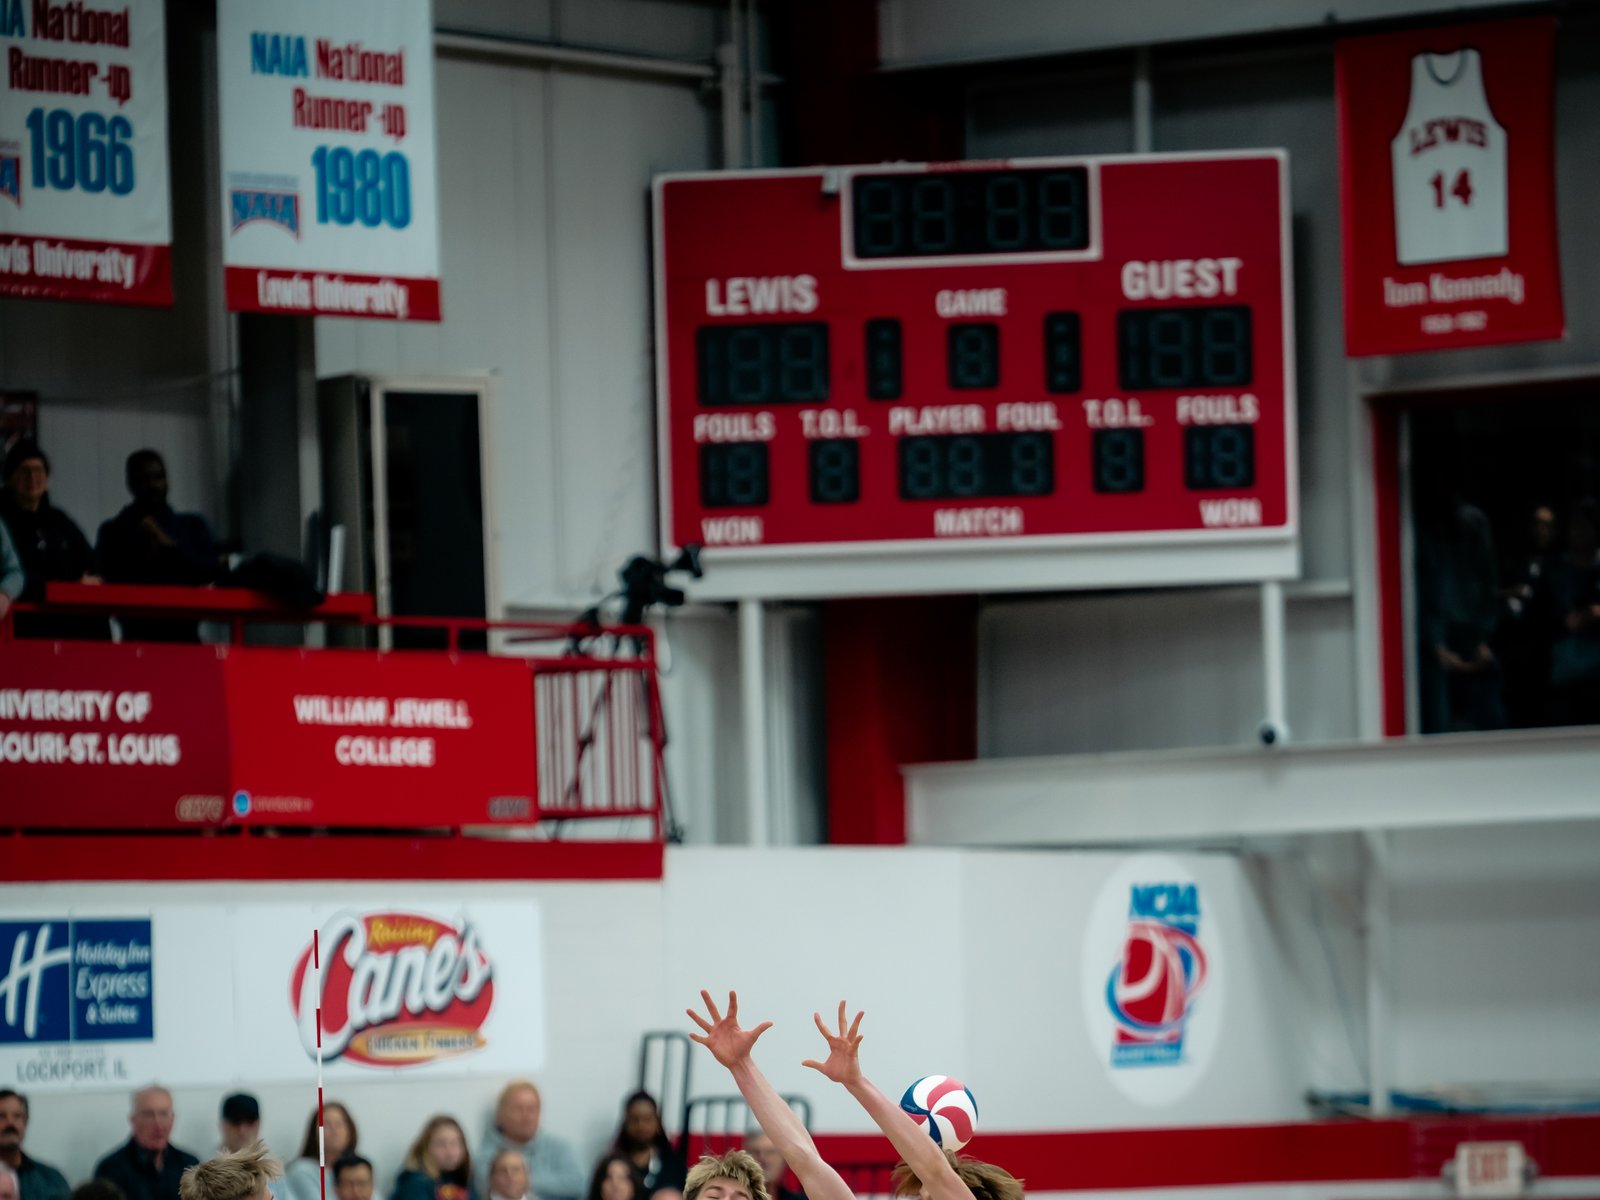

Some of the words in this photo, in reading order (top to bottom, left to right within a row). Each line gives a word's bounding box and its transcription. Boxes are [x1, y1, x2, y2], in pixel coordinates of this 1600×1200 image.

[31, 0, 130, 48] National
[8, 46, 131, 106] Runner-up
[250, 32, 309, 78] NAIA
[315, 39, 404, 87] National
[293, 87, 405, 139] Runner-up
[26, 107, 136, 196] 1966
[1410, 117, 1488, 156] LEWIS
[311, 145, 412, 230] 1980
[1430, 168, 1474, 211] 14
[33, 240, 137, 289] University
[1121, 257, 1244, 300] GUEST
[257, 272, 308, 308] Lewis
[312, 275, 408, 317] University
[706, 274, 819, 317] LEWIS
[935, 288, 1007, 318] GAME
[799, 409, 870, 438] T.O.L.
[889, 405, 986, 435] PLAYER
[997, 403, 1062, 431] FOUL
[1083, 399, 1154, 428] T.O.L.
[1177, 394, 1260, 425] FOULS
[694, 413, 775, 442] FOULS
[702, 516, 762, 545] WON
[934, 507, 1023, 537] MATCH
[1200, 499, 1262, 528] WON
[116, 691, 152, 723] OF
[294, 695, 385, 727] WILLIAM
[391, 698, 472, 729] JEWELL
[107, 733, 181, 767] LOUIS
[335, 735, 435, 767] COLLEGE
[370, 919, 435, 948] Raising
[75, 940, 128, 969] Holiday
[128, 939, 150, 965] Inn
[75, 966, 150, 1003] Express
[299, 908, 493, 1063] Cane's
[99, 1002, 139, 1025] Suites
[16, 1058, 108, 1083] LOCKPORT,
[113, 1059, 128, 1080] IL
